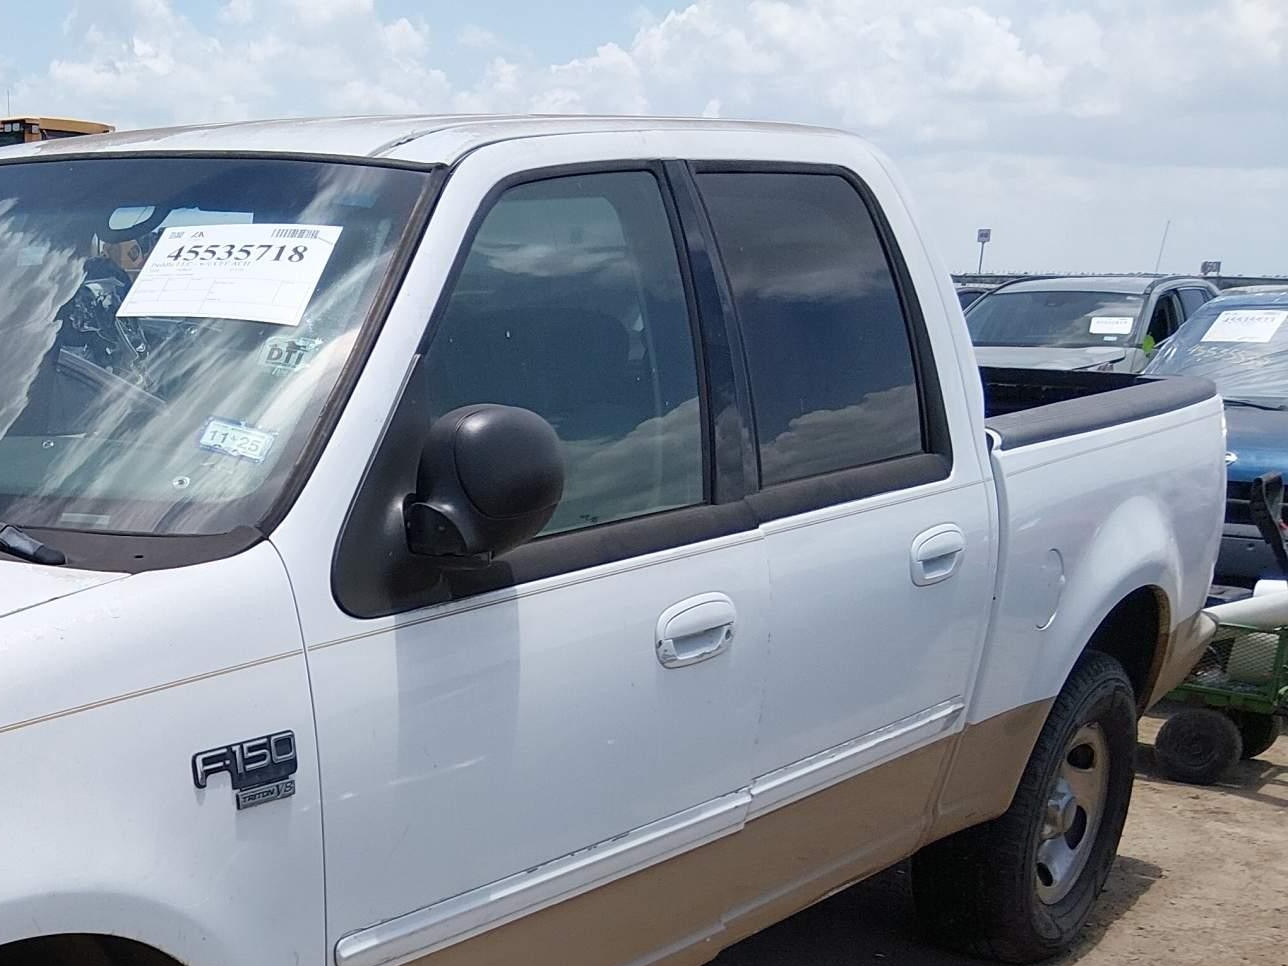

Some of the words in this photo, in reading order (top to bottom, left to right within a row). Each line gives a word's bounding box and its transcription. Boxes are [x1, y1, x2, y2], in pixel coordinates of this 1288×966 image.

[167, 244, 309, 263] 45535718
[237, 436, 259, 452] 25
[242, 789, 275, 804] TRITON
[275, 782, 295, 798] V8
